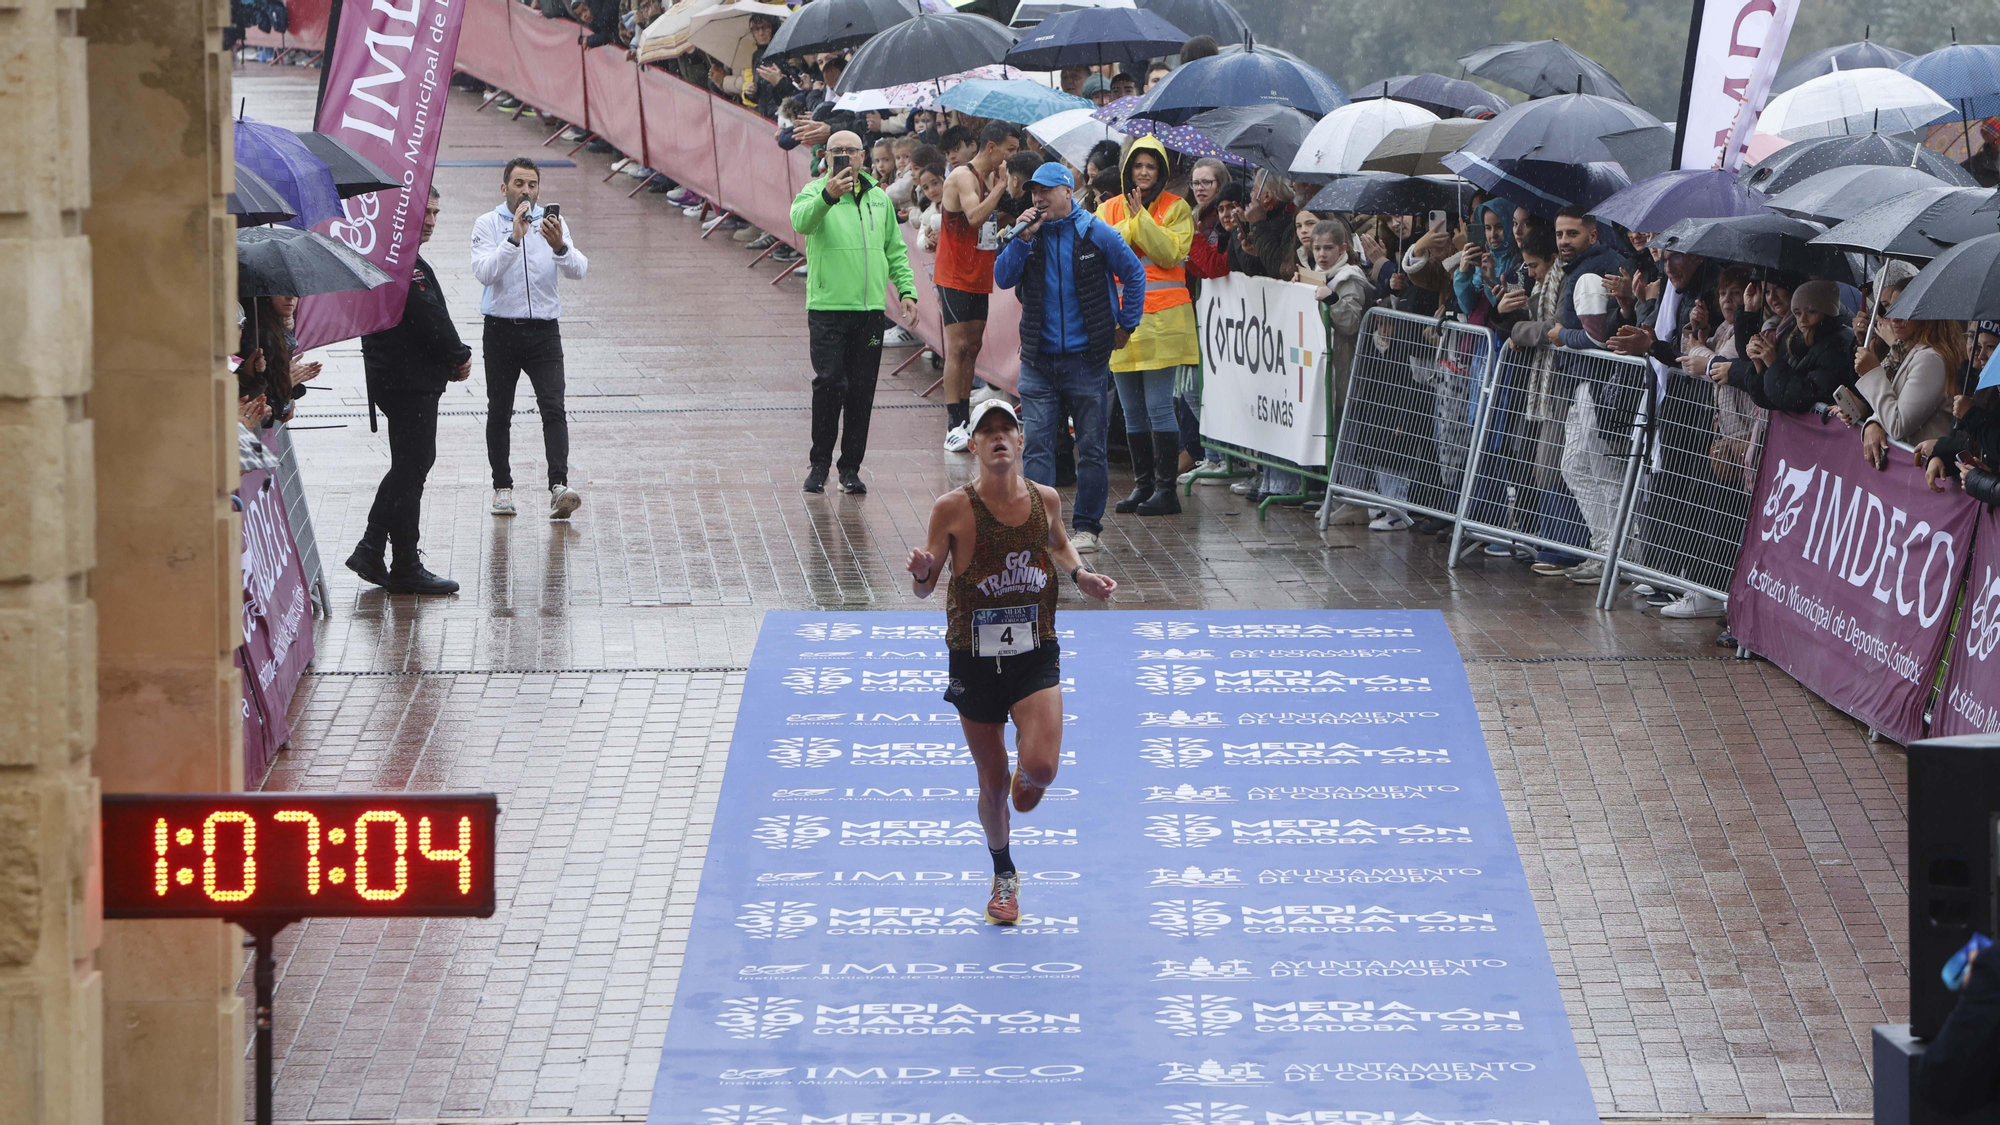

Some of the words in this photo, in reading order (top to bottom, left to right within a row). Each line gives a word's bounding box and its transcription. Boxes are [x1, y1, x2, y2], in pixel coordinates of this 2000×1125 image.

[386, 170, 414, 265] Instituto
[405, 48, 440, 164] Municipal
[430, 13, 446, 44] de
[1802, 468, 1955, 629] IMDECO
[1005, 550, 1031, 570] GO
[977, 566, 1048, 597] TRAINING
[994, 584, 1025, 598] running
[1026, 583, 1041, 594] club
[1786, 583, 1834, 631] Municipal
[1832, 610, 1845, 638] de
[1844, 616, 1888, 663] Deportes
[1000, 626, 1014, 645] 4
[1216, 675, 1430, 685] MARATÓN
[1238, 711, 1440, 719] AYUNTAMIENTO
[1222, 742, 1360, 750] MEDIA
[1223, 746, 1449, 758] MARATÓN
[1223, 757, 1361, 766] CÓRDOBA
[1247, 785, 1460, 793] AYUNTAMIENTO
[842, 820, 983, 829] MEDIA
[1231, 818, 1376, 828] MEDIA
[1232, 824, 1470, 836] MARATÓN
[838, 838, 983, 846] CÓRDOBA
[1232, 836, 1378, 844] CÓRDOBA
[154, 810, 472, 902] 1:07:04
[1258, 868, 1482, 877] AYUNTAMIENTO
[830, 907, 982, 917] MEDIA
[1241, 905, 1395, 915] MEDIA
[1242, 911, 1494, 924] MARATÓN
[826, 927, 980, 935] CÓRDOBA
[1242, 924, 1398, 933] CÓRDOBA
[820, 962, 1083, 974] IMDECO
[1270, 959, 1507, 969] AYUNTAMIENTO
[1270, 969, 1308, 977] DE
[816, 1004, 979, 1014] MEDIA
[1252, 1001, 1416, 1012] MEDIA
[816, 1010, 1080, 1026] MARATÓN
[1255, 1008, 1521, 1022] MARATÓN
[812, 1025, 975, 1035] CÓRDOBA
[998, 1026, 1081, 1034] 2025
[1254, 1022, 1419, 1032] CÓRDOBA
[805, 1065, 1085, 1079] IMDECO
[1284, 1062, 1536, 1073] AYUNTAMIENTO
[1285, 1072, 1325, 1082] DE
[801, 1112, 973, 1124] MEDIA
[1266, 1111, 1439, 1122] MEDIA
